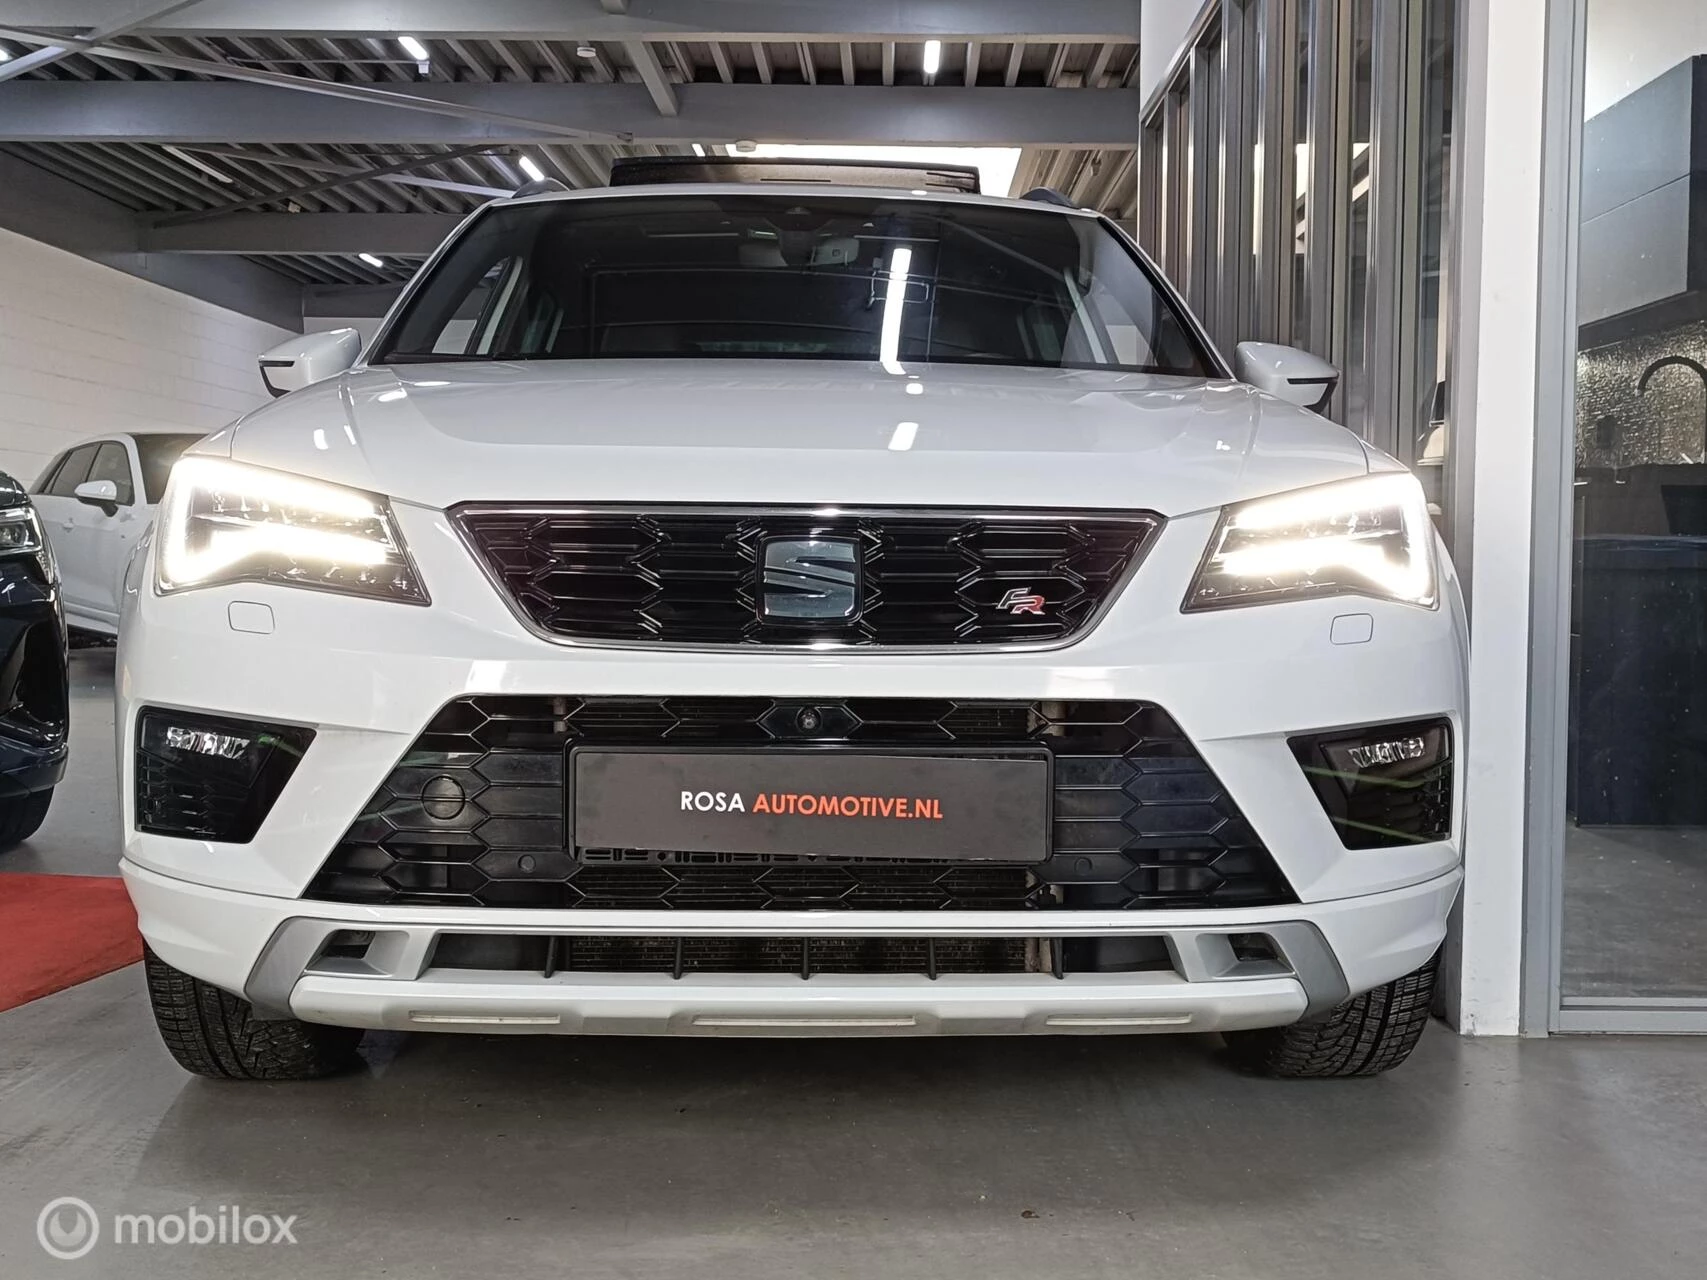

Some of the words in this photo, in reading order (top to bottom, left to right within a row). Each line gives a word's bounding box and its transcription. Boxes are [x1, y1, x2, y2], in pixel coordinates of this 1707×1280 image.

[995, 586, 1046, 616] FR
[680, 790, 746, 813] ROSA
[752, 793, 944, 820] AUTOMOTIVE.NL
